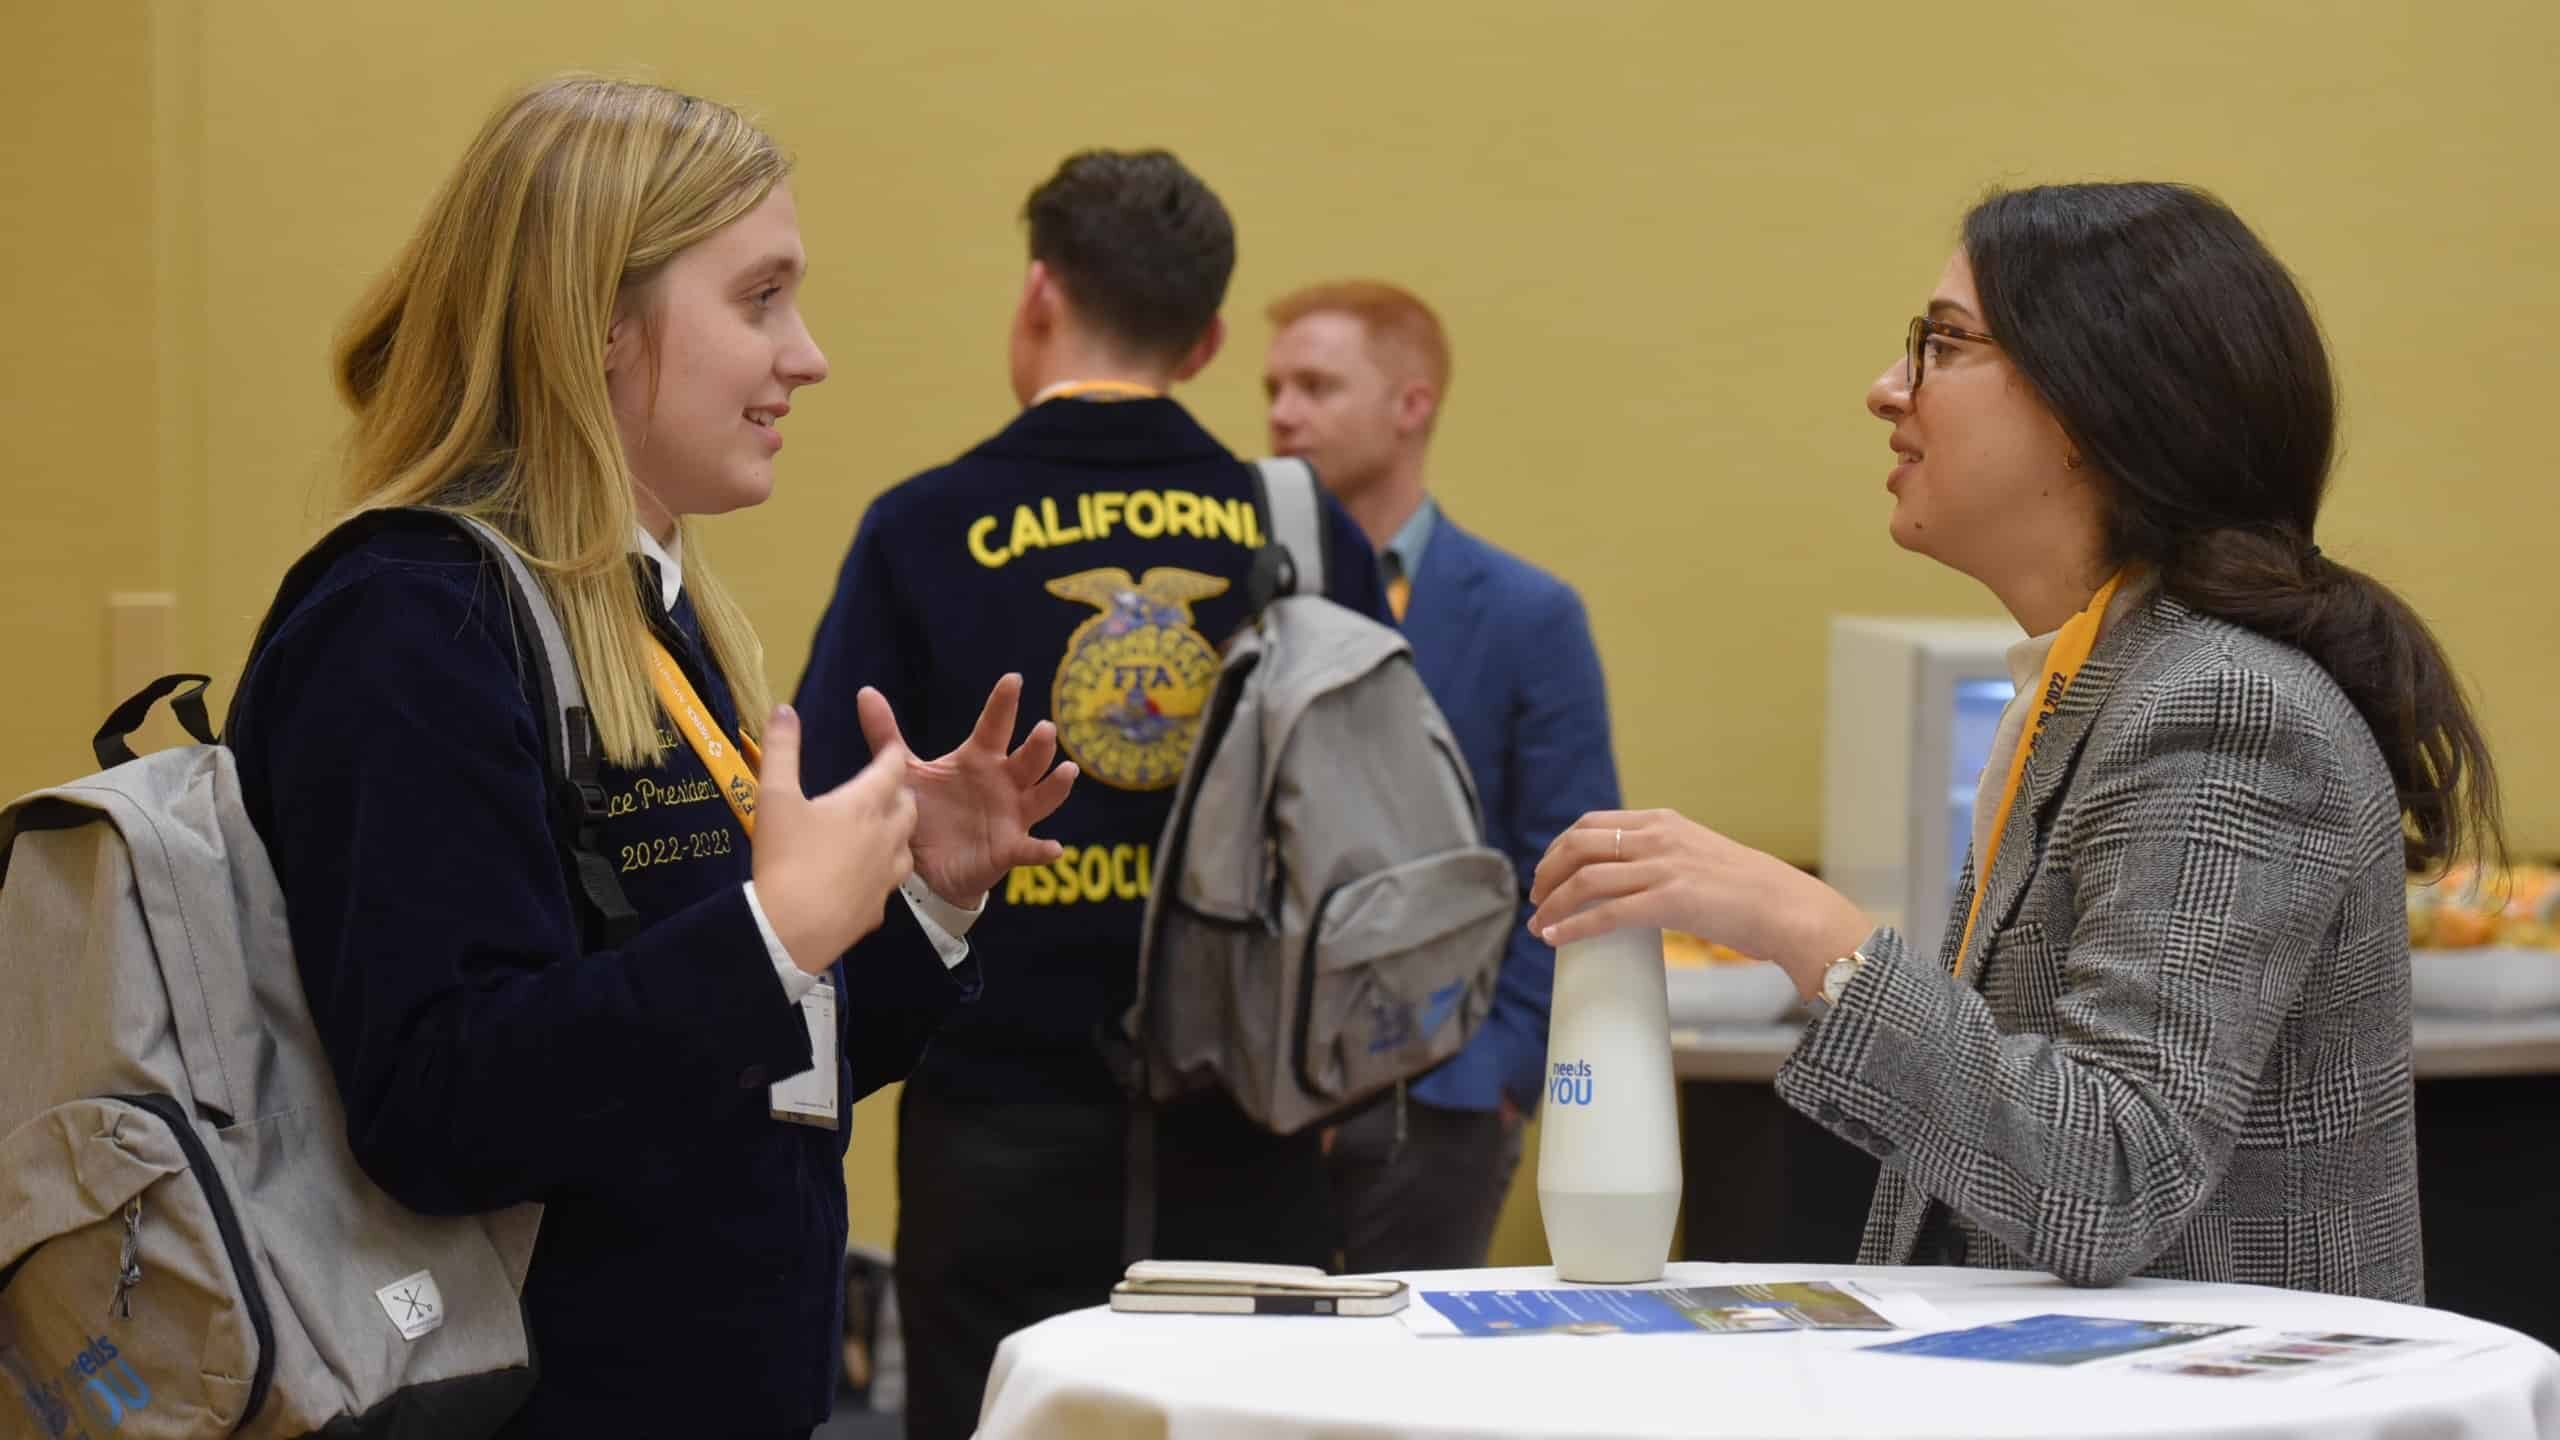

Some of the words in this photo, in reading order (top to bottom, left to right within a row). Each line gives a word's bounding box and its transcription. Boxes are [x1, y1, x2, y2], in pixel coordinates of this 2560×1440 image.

[967, 489, 1265, 568] CALIFORNI
[621, 828, 732, 873] 2022-2023
[1006, 843, 1151, 906] ASSOCI
[1548, 1077, 1593, 1106] YOU
[1552, 1059, 1592, 1077] needs
[81, 1359, 153, 1426] OU
